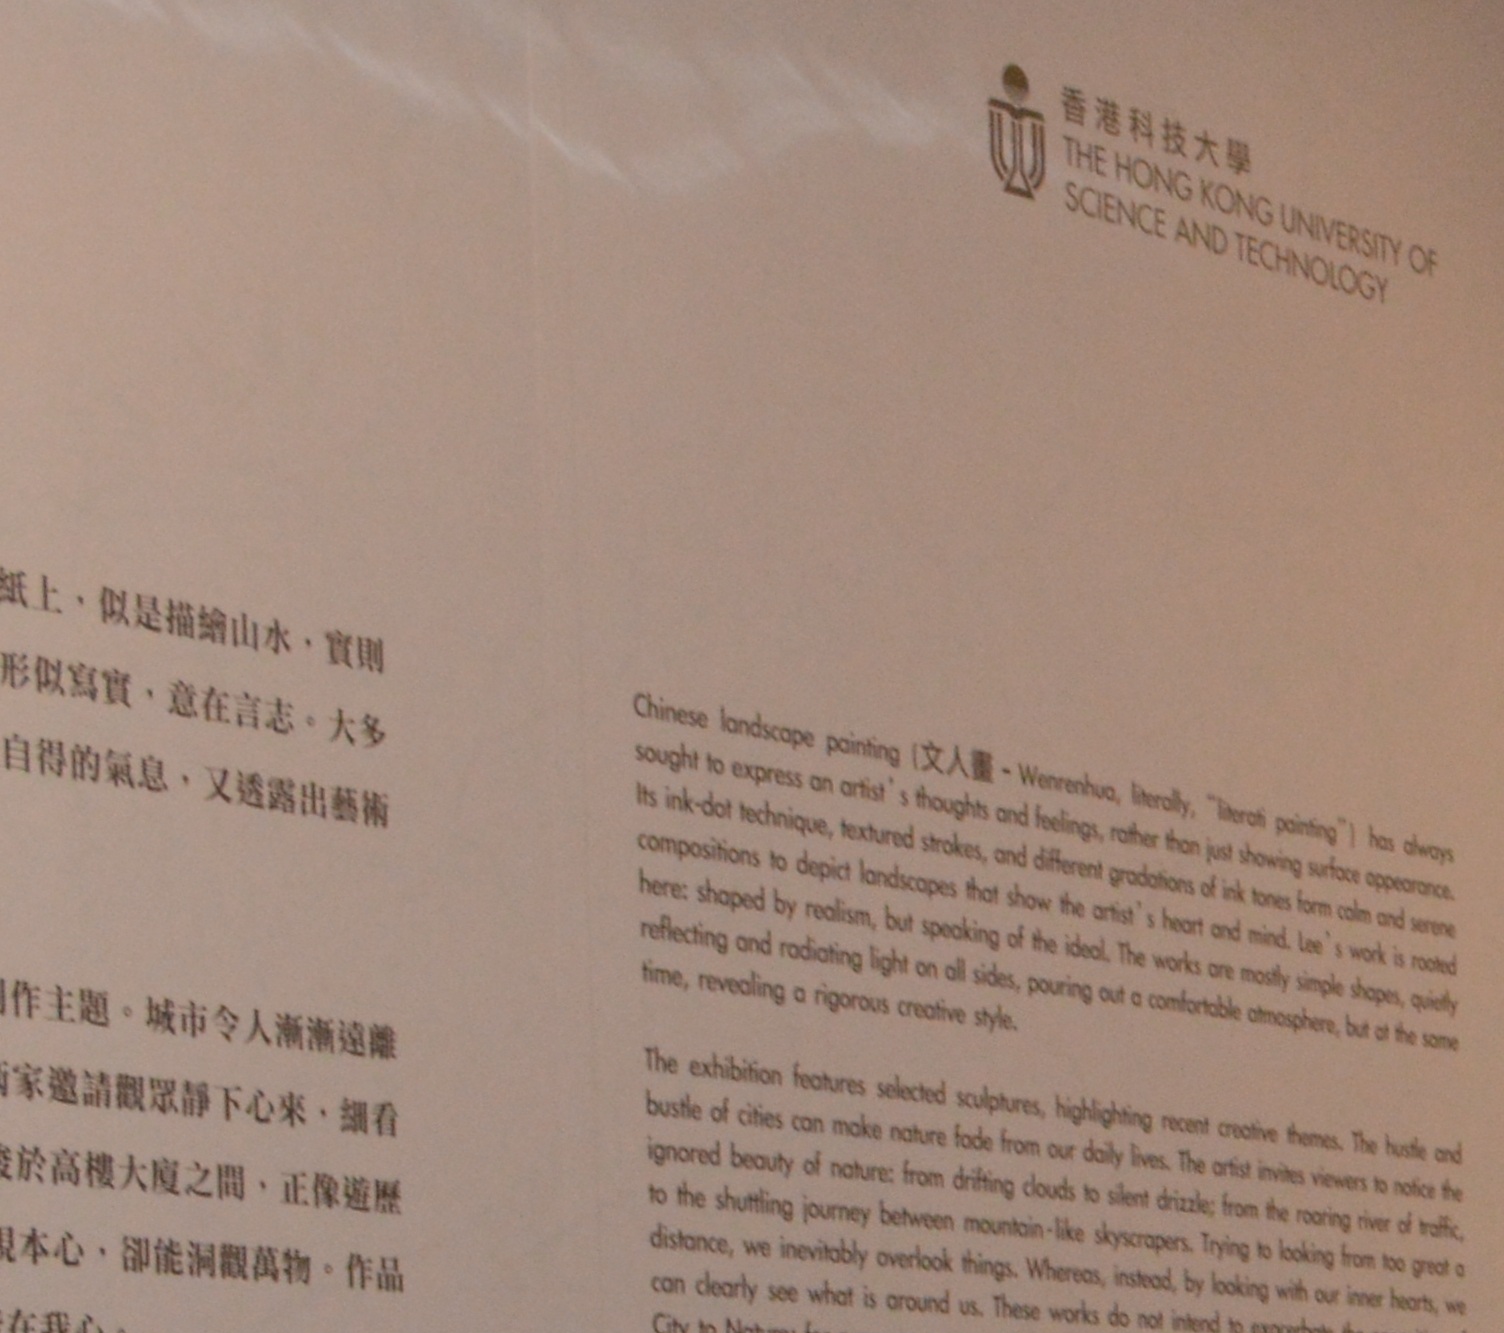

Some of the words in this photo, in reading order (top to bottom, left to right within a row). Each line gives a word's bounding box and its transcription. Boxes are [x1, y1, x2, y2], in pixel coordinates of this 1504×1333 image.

[1061, 85, 1252, 175] 香港科技大學
[1063, 135, 1107, 177] THE
[1116, 152, 1194, 201] HONG
[1200, 179, 1274, 228] KONG
[1280, 204, 1402, 267] UNIVERSITY
[1409, 244, 1437, 278] OF
[1066, 182, 1168, 239] SCIENCE
[1174, 219, 1229, 257] AND
[1235, 232, 1390, 304] TECHNOLOGY
[633, 692, 708, 730] Chinese
[720, 707, 815, 751] landscape
[826, 731, 901, 770] painting
[636, 743, 699, 774] sought
[707, 752, 725, 776] to
[732, 760, 803, 790] express
[810, 774, 833, 794] an
[916, 785, 989, 822] thoughts
[996, 803, 1029, 828] and
[1111, 822, 1159, 849] rather
[636, 780, 658, 809] Its
[666, 785, 732, 820] ink-dot
[841, 817, 915, 851] textured
[995, 844, 1028, 869] and
[1034, 847, 1103, 880] different
[637, 831, 761, 869] compositions
[770, 849, 788, 873] to
[797, 851, 851, 884] depict
[860, 859, 957, 900] landscapes
[966, 877, 999, 905] that
[1008, 884, 1051, 913] show
[1060, 891, 1085, 919] the
[641, 916, 729, 956] reflecting
[736, 931, 772, 957] and
[780, 937, 863, 974] radiating
[870, 946, 909, 979] light
[916, 960, 938, 979] on
[945, 958, 966, 983] all
[1028, 975, 1093, 1007] pouring
[1099, 984, 1125, 1006] out
[1131, 990, 1142, 1009] a
[698, 880, 766, 914] shaped
[774, 890, 797, 922] by
[885, 906, 914, 933] but
[923, 918, 1000, 952] speaking
[1008, 926, 1024, 950] of
[1032, 929, 1057, 955] the
[1118, 941, 1146, 969] The
[0, 978, 398, 1061] 作主題。城市令人漸漸遠離
[698, 972, 786, 1007] revealing
[794, 985, 806, 1005] a
[815, 982, 890, 1016] rigorous
[898, 998, 966, 1026] creative
[0, 1061, 400, 1139] 家邀請觀眾靜下心來，細看
[645, 1047, 679, 1076] The
[689, 1055, 783, 1087] exhibition
[793, 1064, 866, 1097] features
[878, 1076, 947, 1107] selected
[1056, 1094, 1153, 1135] highlighting
[646, 1091, 702, 1122] bustle
[711, 1099, 729, 1125] of
[738, 1102, 784, 1131] cities
[792, 1113, 825, 1134] can
[833, 1114, 882, 1141] make
[890, 1123, 947, 1148] nature
[954, 1124, 993, 1153] fade
[1001, 1129, 1040, 1157] from
[1048, 1142, 1076, 1161] our
[1083, 1139, 1123, 1171] daily
[648, 1135, 721, 1168] ignored
[730, 1143, 794, 1179] beauty
[803, 1152, 821, 1177] of
[903, 1161, 944, 1189] from
[953, 1166, 1015, 1202] drifting
[1023, 1174, 1076, 1203] clouds
[1084, 1183, 1100, 1204] to
[1108, 1182, 1149, 1209] silent
[649, 1182, 668, 1206] to
[677, 1182, 706, 1210] the
[716, 1186, 794, 1223] shuttling
[803, 1194, 871, 1229] journey
[879, 1201, 954, 1232] between
[964, 1216, 1084, 1244] mountain-like
[744, 1239, 771, 1258] we
[780, 1235, 868, 1271] inevitably
[877, 1246, 953, 1273] overlook
[651, 1275, 686, 1296] can
[696, 1272, 758, 1306] clearly
[769, 1283, 798, 1304] see
[808, 1281, 854, 1308] what
[864, 1284, 877, 1310] is
[886, 1291, 950, 1315] around
[994, 1294, 1040, 1322] These
[1049, 1301, 1100, 1326] works
[1108, 1303, 1130, 1328] do
[1138, 1311, 1164, 1330] not
